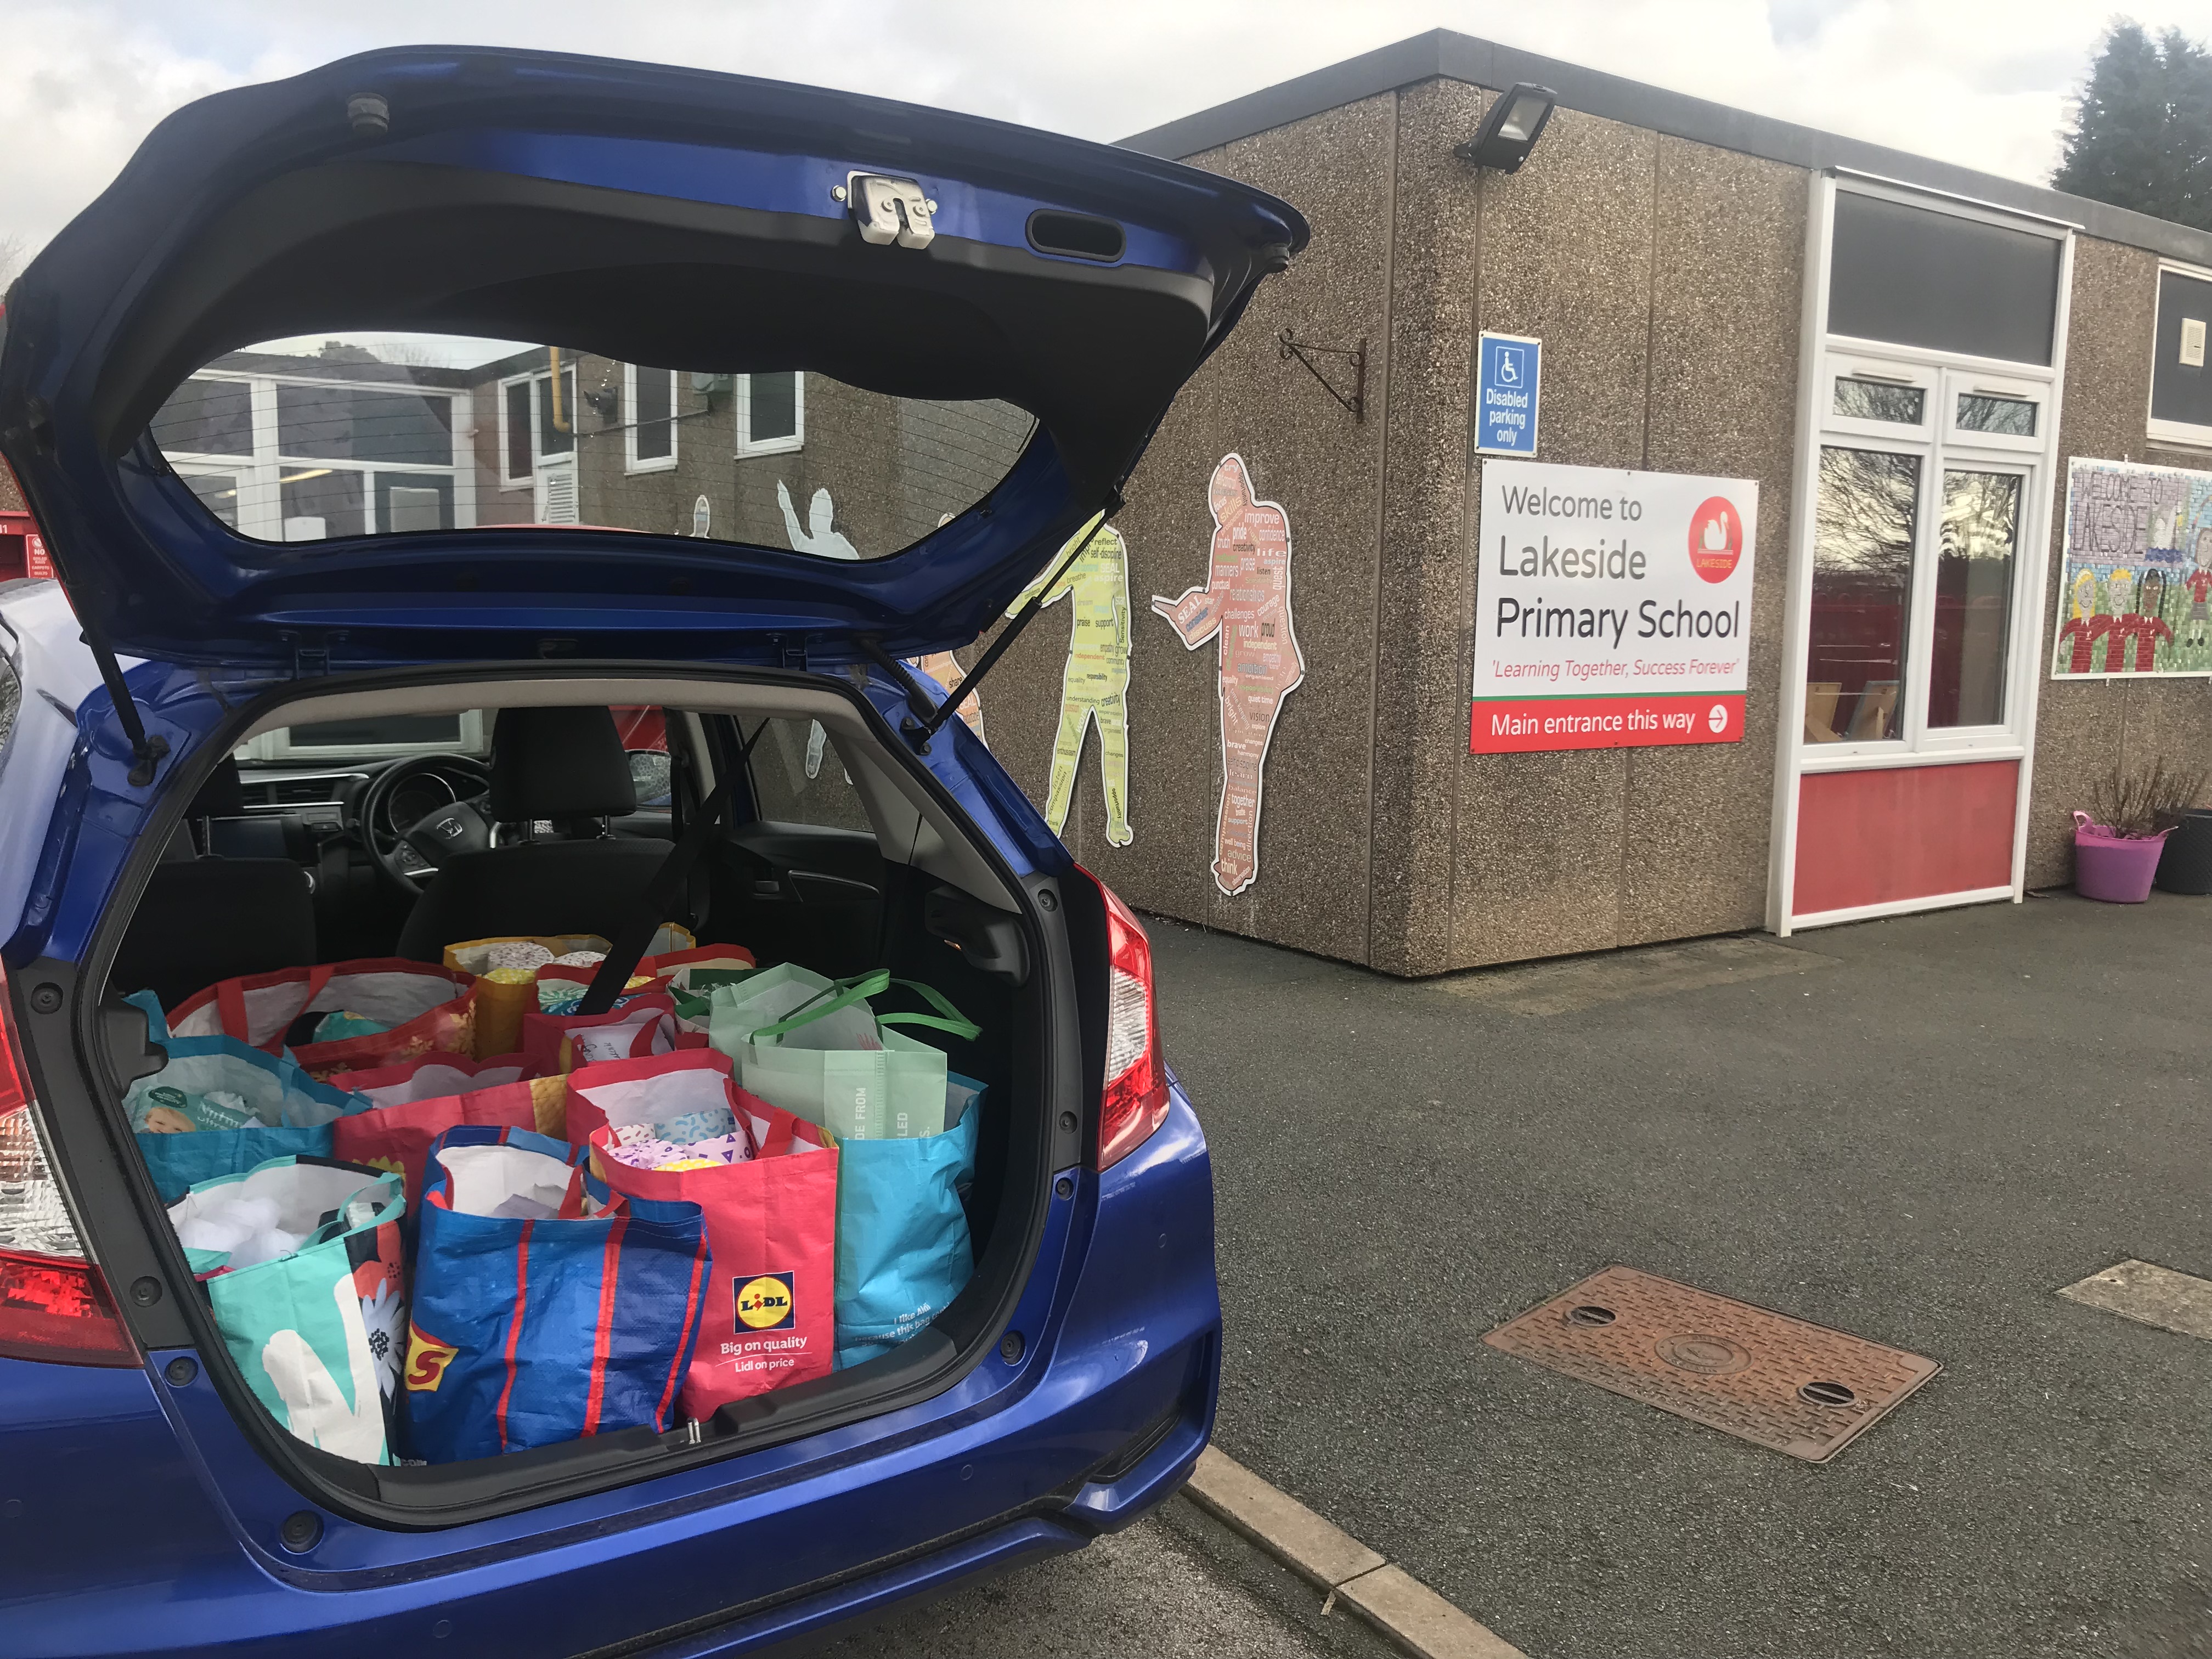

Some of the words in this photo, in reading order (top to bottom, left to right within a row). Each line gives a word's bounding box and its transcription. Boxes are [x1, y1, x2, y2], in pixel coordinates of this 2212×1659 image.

[1486, 388, 1528, 408] Disabled
[1489, 409, 1526, 430] parking
[1497, 427, 1517, 447] only
[1224, 465, 1239, 473] try
[1238, 471, 1248, 506] opportunity
[1214, 495, 1227, 512] focus
[1220, 496, 1242, 523] skills
[1502, 485, 1612, 520] Welcome
[1619, 497, 1642, 521] to
[1244, 509, 1279, 527] improve
[1232, 522, 1247, 544] pride
[1259, 525, 1285, 542] confidence
[1066, 537, 1081, 558] bright
[1217, 534, 1231, 549] truth
[1233, 541, 1256, 555] creativity
[1257, 548, 1286, 557] life
[1499, 535, 1647, 580] Lakeside
[1101, 563, 1120, 573] SEAL
[1240, 552, 1256, 576] praise
[1263, 557, 1286, 566] aspire
[1696, 558, 1733, 568] LAKESIDE
[1066, 573, 1086, 583] breathe
[1094, 573, 1124, 584] aspire
[1215, 565, 1239, 577] manners
[1256, 566, 1271, 575] listen
[1272, 566, 1286, 590] quest
[1211, 578, 1230, 592] punctual
[1178, 595, 1203, 624] SEAL
[1257, 594, 1280, 617] courage
[1077, 617, 1091, 629] praise
[1224, 607, 1255, 623] challenges
[1095, 618, 1114, 630] support
[1119, 607, 1127, 644] Sensitivity
[1189, 617, 1217, 641] discuss
[1239, 620, 1259, 638] work
[1261, 618, 1276, 642] proud
[1277, 606, 1288, 645] question
[1497, 597, 1628, 650] Primary
[1638, 600, 1740, 639] School
[1115, 646, 1127, 657] grow
[1243, 638, 1277, 652] independent
[1492, 659, 1560, 682] 'Learning
[1565, 659, 1629, 681] Together,
[1633, 658, 1685, 676] Success
[1689, 658, 1740, 675] Forever'
[1068, 676, 1086, 685] equality
[1222, 675, 1238, 686] equality
[1066, 695, 1101, 706] understanding
[1101, 692, 1120, 707] creativity
[1248, 694, 1261, 704] quiet
[1261, 696, 1273, 704] time
[1224, 696, 1239, 726] bright
[1237, 702, 1250, 730] keeping
[1249, 710, 1270, 723] vision
[1100, 716, 1111, 725] brave
[1491, 713, 1538, 736] Main
[1544, 714, 1623, 734] entrance
[1627, 709, 1658, 731] this
[1662, 712, 1696, 735] way
[1227, 740, 1246, 750] brave
[1244, 737, 1264, 747] changes
[1057, 747, 1076, 757] enthusiasm
[1237, 750, 1259, 759] harmony
[1052, 765, 1063, 790] listen
[1229, 769, 1254, 780] learn
[1048, 771, 1067, 815] compassion
[1228, 784, 1257, 795] balance
[1111, 788, 1122, 819] opportunity
[1231, 793, 1255, 809] together
[1219, 793, 1231, 855] compassion
[1228, 817, 1249, 826] support
[1224, 838, 1234, 846] well
[1233, 838, 1246, 851] being
[1227, 849, 1252, 862] advice
[1221, 857, 1238, 876] think
[855, 1087, 866, 1120] FROM
[855, 1125, 866, 1140] DE
[896, 1112, 908, 1139] LED
[896, 1322, 913, 1336] this
[915, 1316, 930, 1328] bag
[720, 1341, 742, 1356] Big
[744, 1342, 761, 1352] on
[763, 1336, 808, 1353] quality
[735, 1360, 753, 1373] Lidl
[754, 1361, 768, 1370] on
[769, 1358, 795, 1371] price
